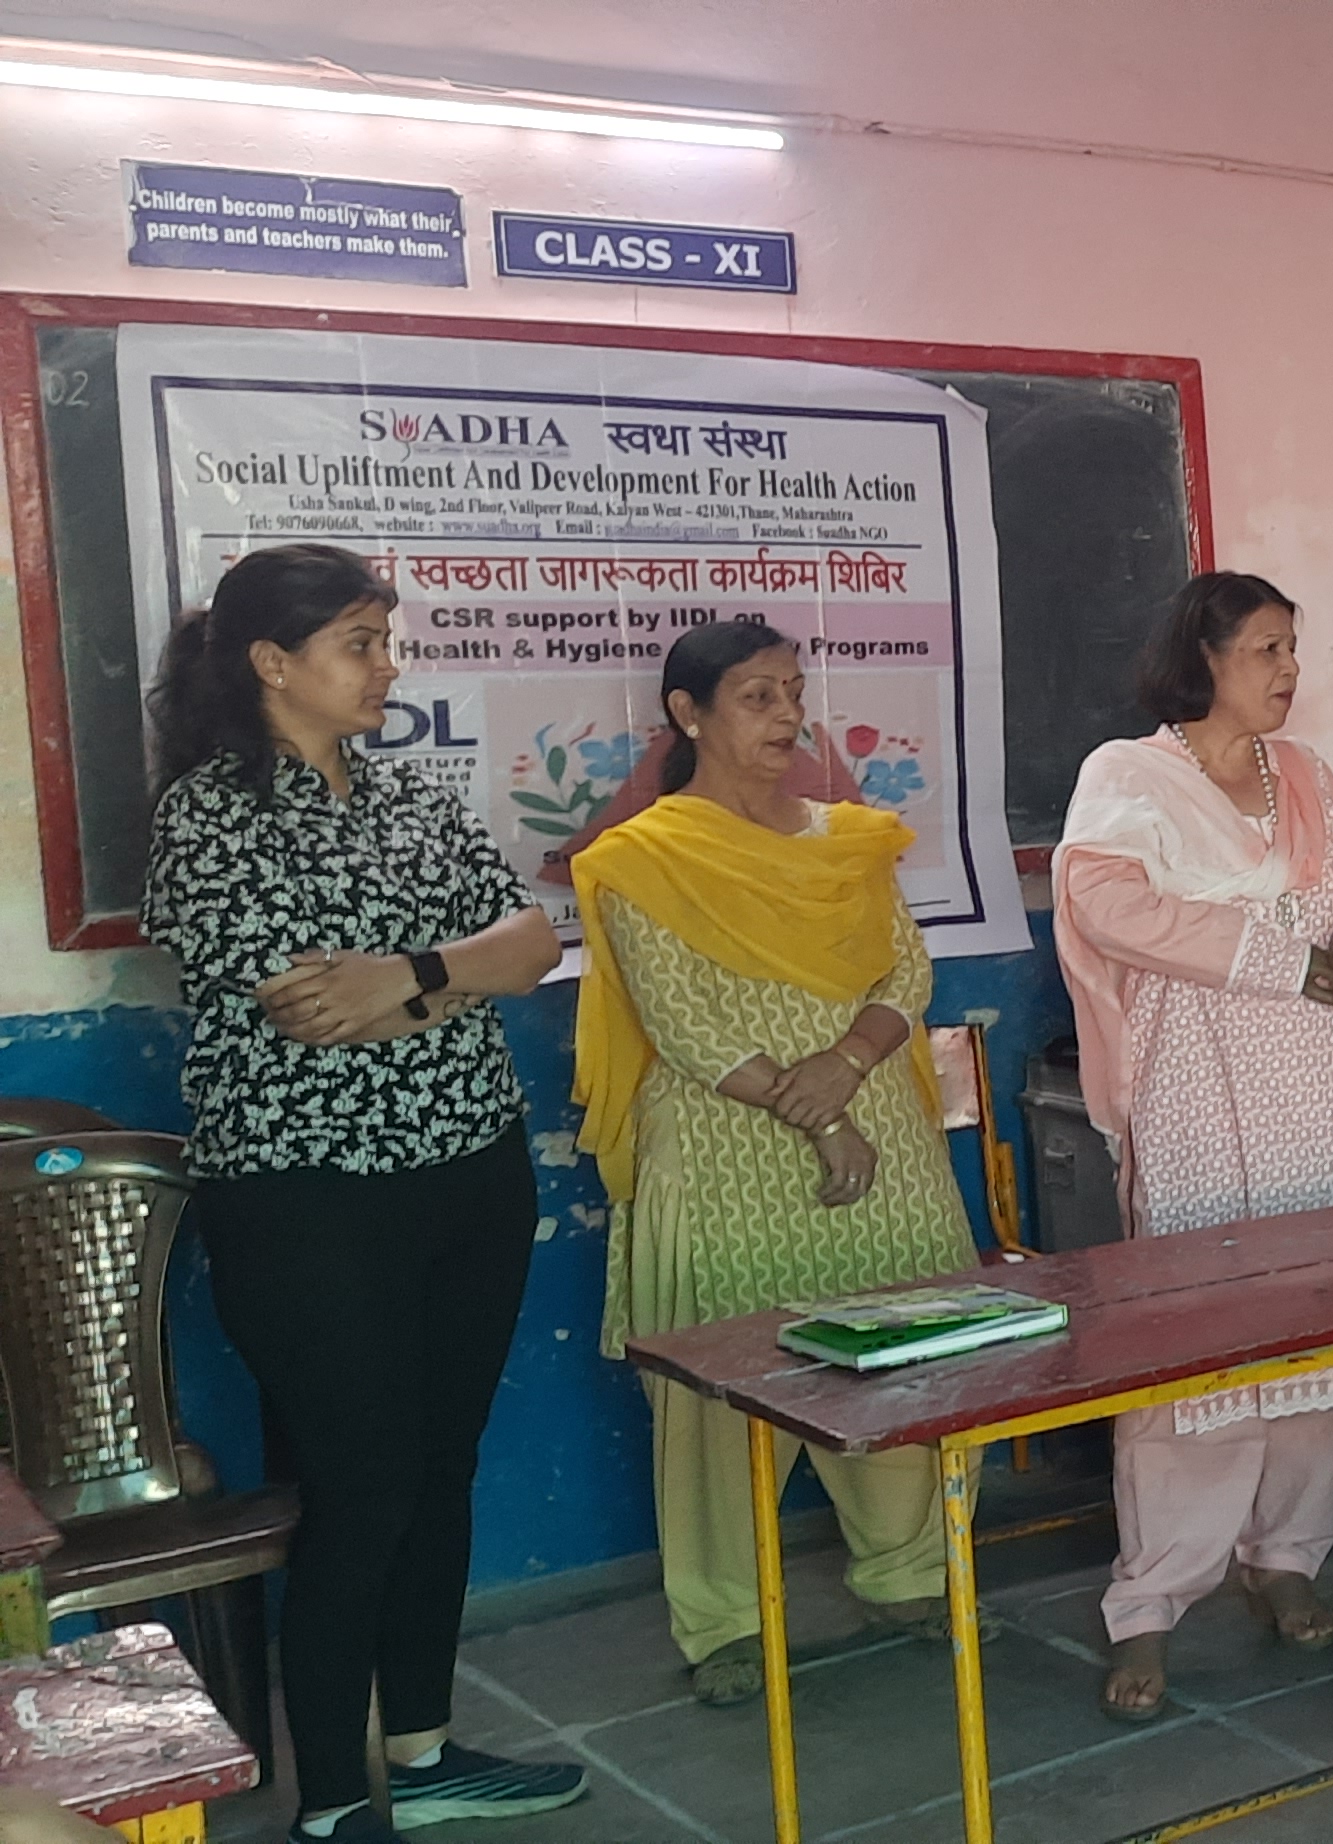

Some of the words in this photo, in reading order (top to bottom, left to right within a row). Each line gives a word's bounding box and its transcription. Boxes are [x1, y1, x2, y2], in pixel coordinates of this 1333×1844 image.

[138, 188, 217, 214] Children
[222, 196, 295, 220] become
[300, 204, 359, 229] mostly
[364, 208, 408, 229] what
[412, 212, 453, 234] their
[147, 222, 219, 243] parents
[224, 225, 257, 245] and
[262, 229, 342, 251] teachers
[347, 234, 395, 255] make
[399, 236, 449, 259] them.
[535, 230, 672, 272] CLASS
[713, 242, 763, 278] XI
[604, 422, 691, 456] स्वधा
[699, 420, 787, 460] संस्था
[196, 450, 288, 486] Social
[300, 453, 456, 494] Upliftment
[464, 460, 521, 490] And
[530, 462, 700, 501] Development
[708, 467, 751, 497] For
[759, 468, 837, 500] Health
[844, 471, 916, 502] Action
[439, 497, 464, 513] 2nd
[860, 525, 888, 540] NGO
[362, 546, 398, 589] वं
[406, 555, 529, 592] स्वच्छता
[536, 557, 698, 593] जागरूकता
[706, 548, 821, 593] कार्यक्रम
[826, 550, 907, 594] शिबिर
[431, 607, 495, 628] CSR
[506, 609, 620, 632] support
[628, 608, 660, 632] by
[399, 638, 501, 660] Health
[512, 638, 535, 659] &
[546, 638, 662, 664] Hygiene
[809, 637, 929, 660] Programs
